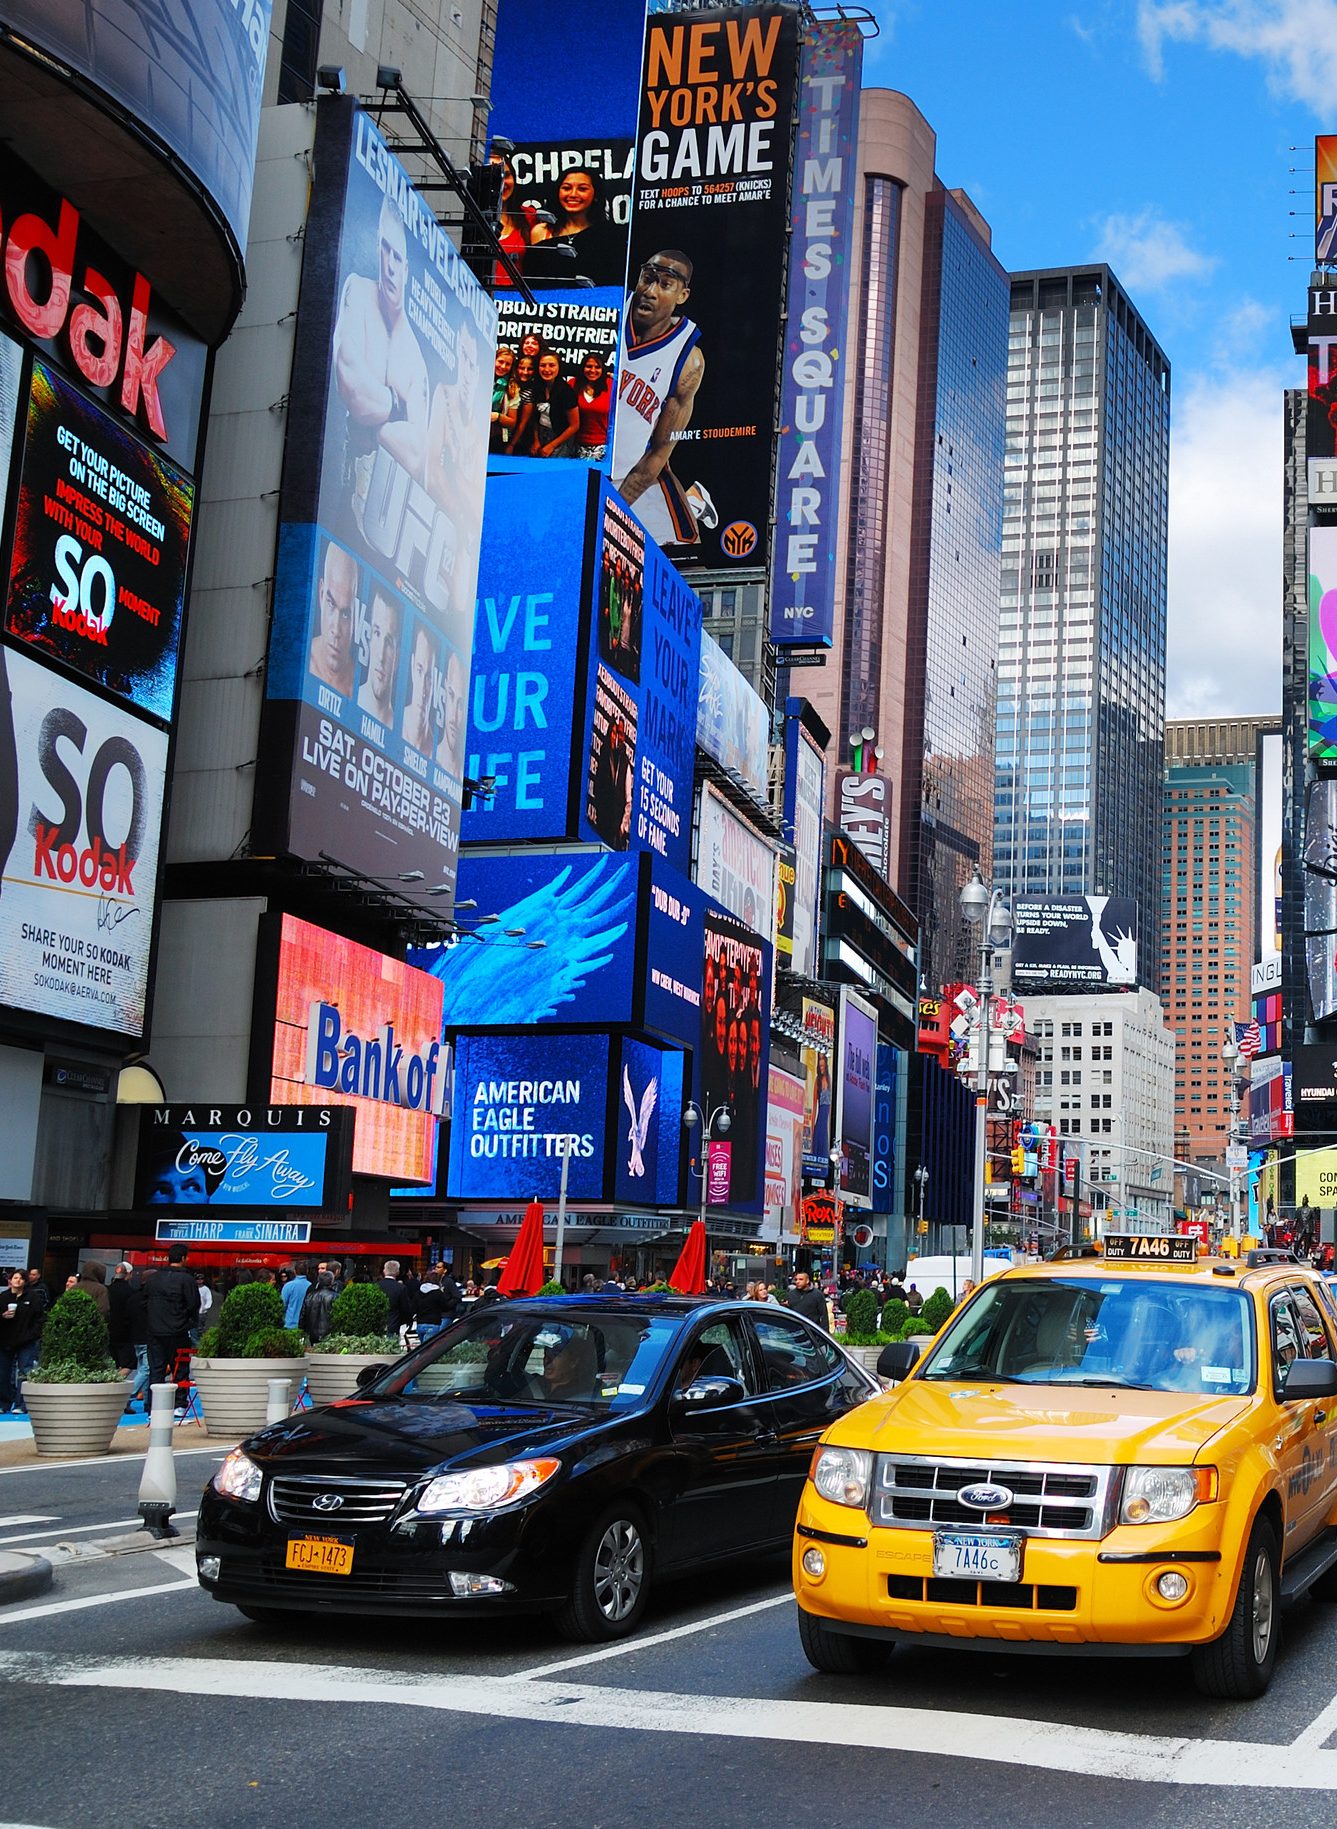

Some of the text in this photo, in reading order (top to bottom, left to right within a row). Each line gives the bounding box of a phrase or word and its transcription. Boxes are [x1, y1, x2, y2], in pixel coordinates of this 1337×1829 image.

[647, 16, 783, 87] NEW
[647, 79, 778, 128] YORK'S
[641, 120, 775, 181] GAME
[639, 189, 771, 210] FOR A CHANCE TO MEET AMAR'E
[640, 188, 660, 200] TEXT
[661, 186, 690, 198] HOOPS
[692, 185, 703, 195] TO
[704, 182, 735, 195] 564257
[355, 113, 498, 351] LESNAR VELASQUEZ
[0, 197, 170, 442] dak
[786, 75, 847, 574] TIMES SQUARE
[670, 426, 757, 441] AMAR'E STOUDEMIRE
[56, 425, 152, 510] GET YOUR PICTURE
[69, 457, 165, 543] ON THE BIG SCREEN
[43, 495, 103, 552] WITH YOUR
[56, 478, 161, 566] IMPRESS THE WORLD
[364, 445, 457, 613] UFC
[50, 534, 116, 633] SO
[118, 585, 161, 627] MOMENT
[652, 556, 692, 649] LEAVE
[784, 607, 815, 620] NYC
[52, 596, 109, 647] Kodak
[654, 625, 689, 703] YOUR
[318, 685, 341, 718] ORTIZ
[361, 714, 385, 749] HAMILL
[302, 737, 341, 779] LIVE
[343, 761, 369, 797] ON
[319, 719, 357, 762] SAT.
[362, 746, 430, 812] OCTOBER
[433, 795, 451, 827] 23
[402, 744, 428, 780] SHIELDS
[640, 756, 674, 804] GET YOUR
[27, 707, 149, 873] SO
[637, 813, 648, 840] OF
[639, 785, 680, 838] 15 SECONDS
[34, 822, 136, 896] Kodak
[1016, 903, 1083, 913] BEFORE DISASTER
[1016, 911, 1089, 921] TURNS YOUR WORLD
[1016, 919, 1069, 928] UPSIDE DOWN,
[21, 923, 132, 972] SHARE YOUR SO KODAK
[1026, 927, 1051, 935] READY.
[42, 951, 113, 986] MOMENT HERE
[1049, 969, 1102, 980] READYNYC.ORG
[306, 1001, 441, 1113] Bank of
[473, 1080, 581, 1105] AMERICAN
[1284, 1074, 1293, 1110] Travelex
[1301, 1087, 1335, 1098] HYUNDAI
[153, 1109, 332, 1127] MARQUIS
[472, 1107, 536, 1131] EAGLE
[470, 1133, 595, 1159] OUTFITTERS
[175, 1134, 317, 1199] Come Fly Away
[190, 1222, 300, 1241] THARP SINATRA
[575, 1213, 671, 1230] EAGLE OUTFITTERS
[1107, 1247, 1190, 1259] DUTY DUTY
[1110, 1237, 1190, 1257] OFF 7A46 OFF
[969, 1489, 997, 1503] Ford
[876, 1550, 931, 1563] ESCAPE
[954, 1537, 998, 1548] NEW YORK
